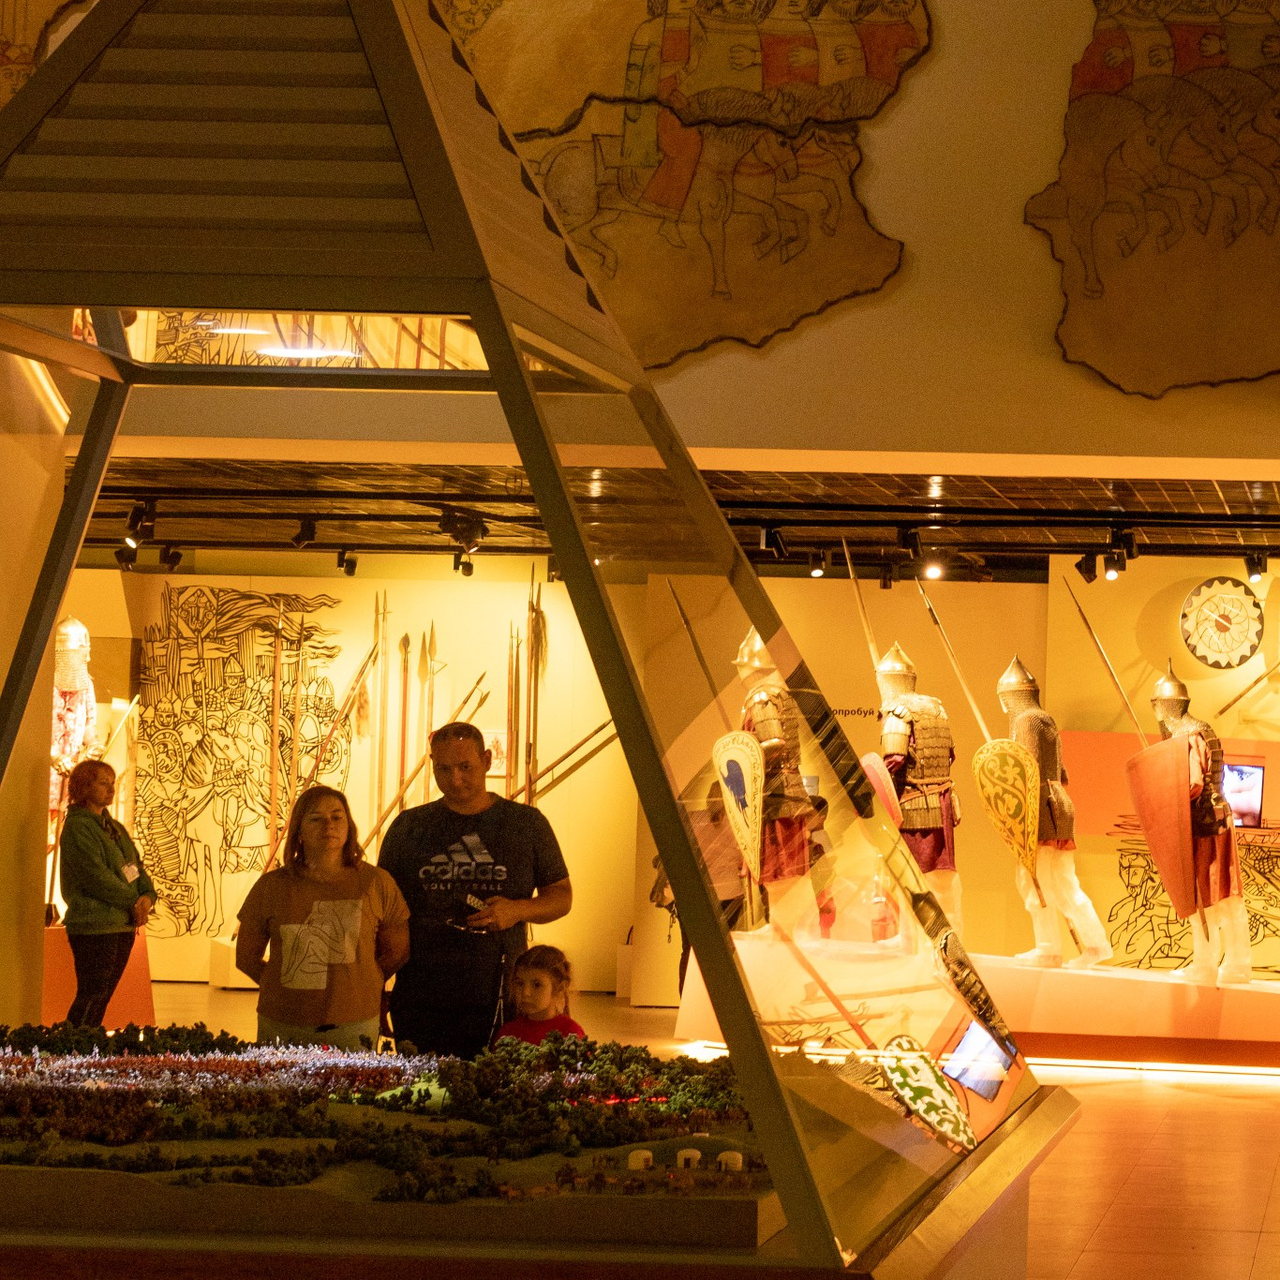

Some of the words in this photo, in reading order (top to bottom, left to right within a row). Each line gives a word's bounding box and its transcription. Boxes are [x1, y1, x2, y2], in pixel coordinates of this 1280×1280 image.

[831, 707, 875, 718] опробуй
[419, 861, 507, 881] adidas
[422, 882, 503, 891] VOLLBALL
